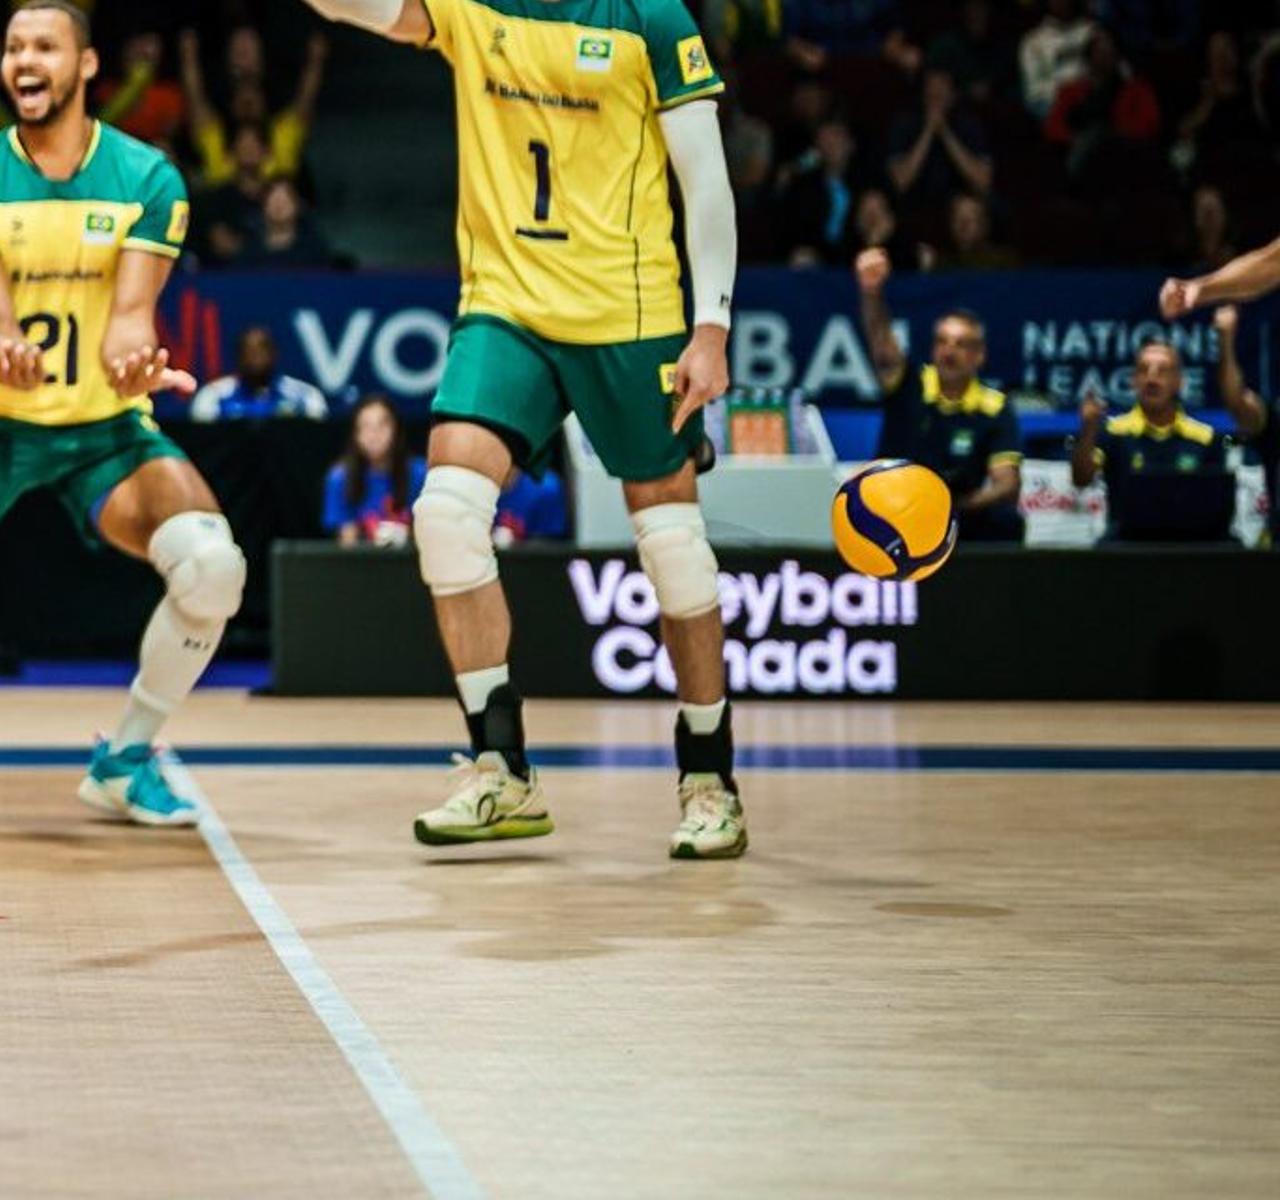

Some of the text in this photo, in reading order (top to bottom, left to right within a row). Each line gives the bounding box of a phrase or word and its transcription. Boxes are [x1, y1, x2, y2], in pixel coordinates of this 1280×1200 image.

[529, 138, 552, 222] 1
[19, 312, 79, 387] 21
[567, 559, 918, 638] Voeyball
